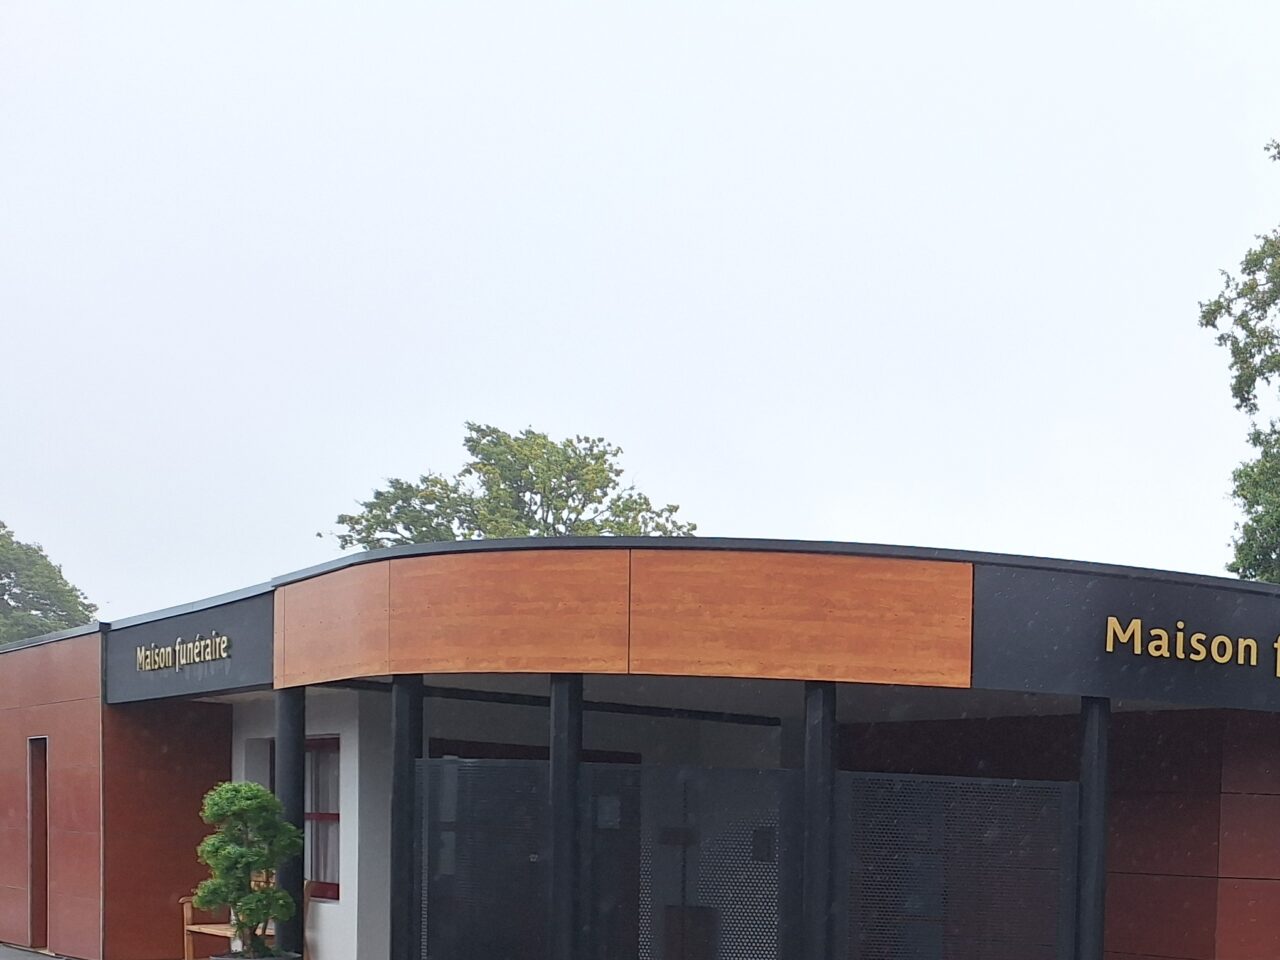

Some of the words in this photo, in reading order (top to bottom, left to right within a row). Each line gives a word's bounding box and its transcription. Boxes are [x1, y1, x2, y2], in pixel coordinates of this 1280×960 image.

[136, 642, 173, 672] Maison
[174, 630, 228, 672] funéraire
[1105, 616, 1258, 666] Maison
